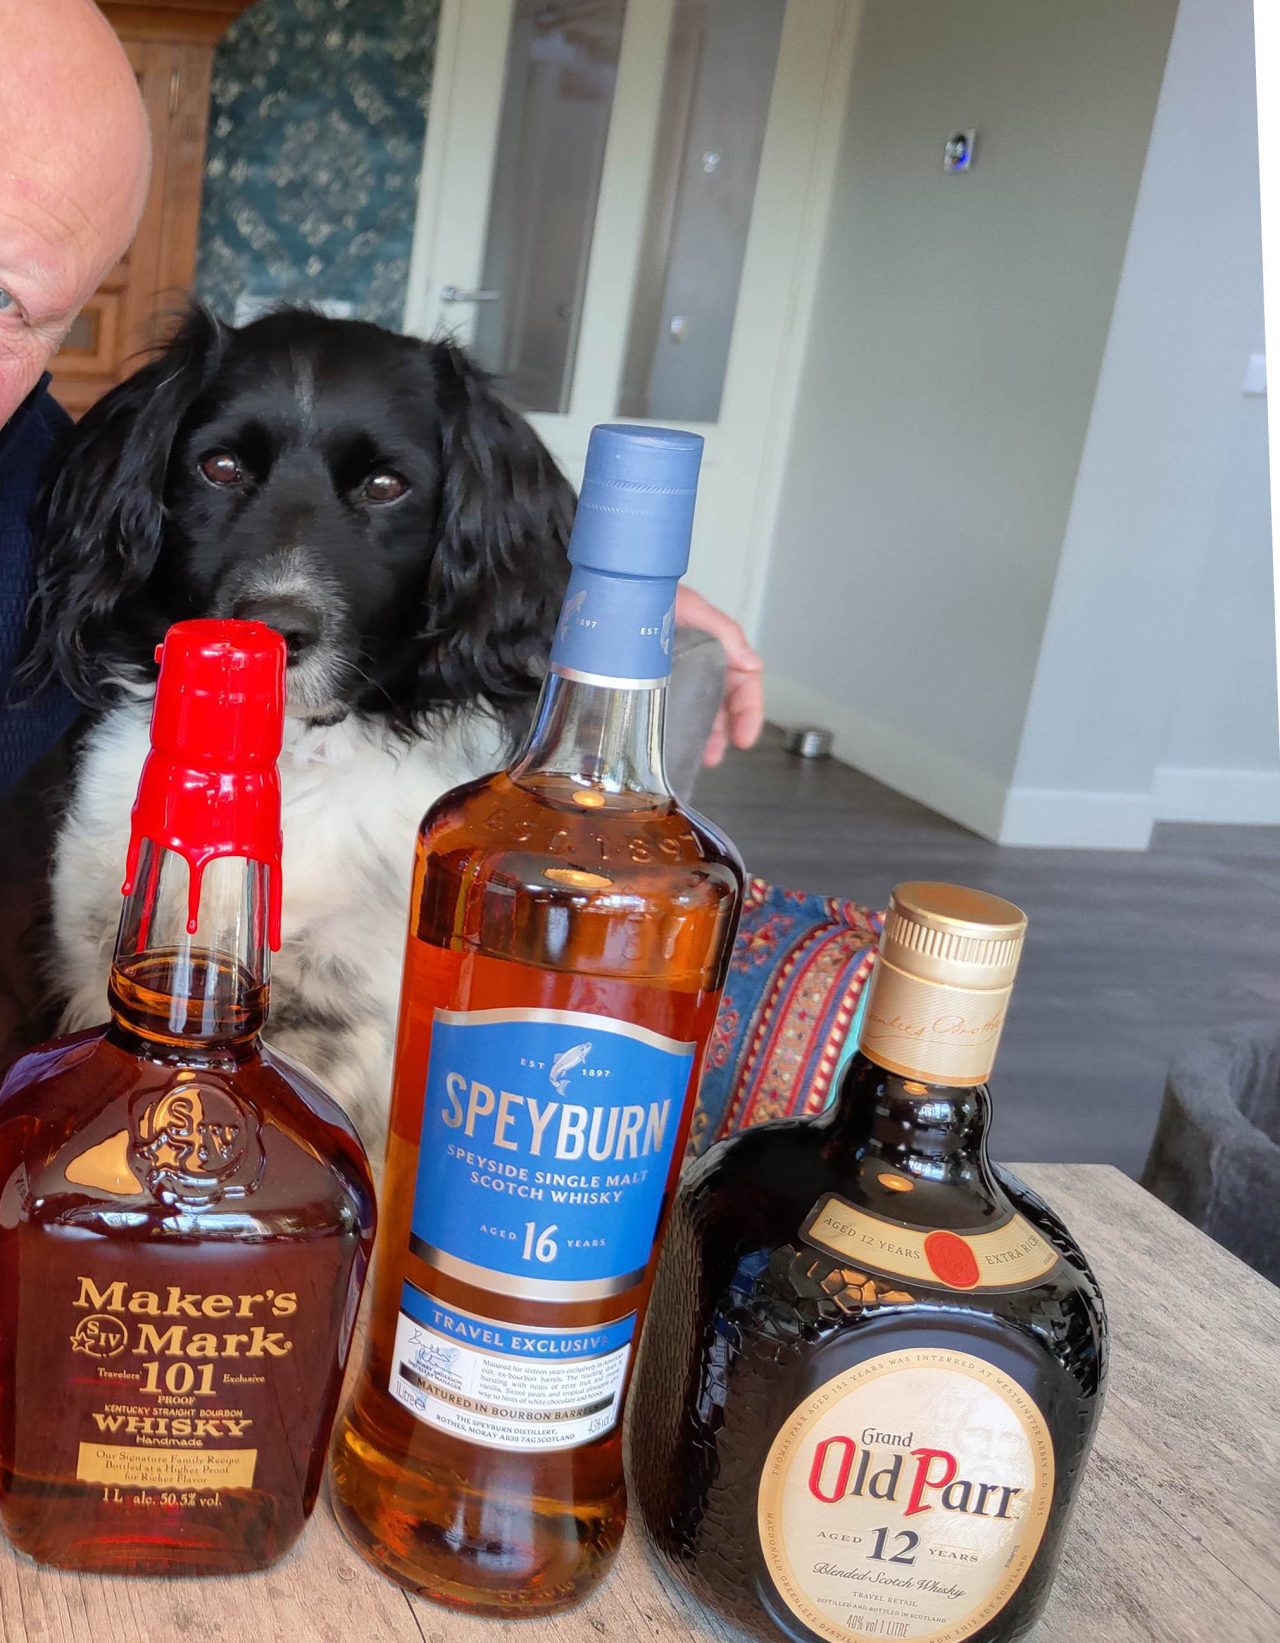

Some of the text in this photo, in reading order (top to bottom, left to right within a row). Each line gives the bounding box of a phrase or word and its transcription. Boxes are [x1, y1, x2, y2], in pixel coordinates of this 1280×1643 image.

[640, 627, 659, 635] EST
[520, 1057, 546, 1069] EST
[582, 1068, 611, 1078] 1897
[441, 1071, 672, 1162] SPEYBURN
[447, 1143, 649, 1188] SPEYSIDE SINGLE MALT
[470, 1171, 624, 1204] SCOTCH WHISKY
[479, 1221, 607, 1263] AGED 16 YEARS
[824, 1217, 921, 1260] AGED 12 YEARS
[984, 1247, 1022, 1265] EXTRA
[1023, 1233, 1040, 1253] RICH
[73, 1276, 298, 1318] Maker's
[432, 1309, 505, 1347] TRAVEL
[139, 1361, 217, 1395] 101
[849, 1362, 884, 1382] YEARS
[888, 1355, 912, 1366] WAS
[917, 1354, 976, 1370] INTERRED
[104, 1404, 243, 1417] KENTUCKY STRAIGHT BOURBON
[157, 1396, 196, 1405] PROOF
[417, 1377, 472, 1408] MATURED
[475, 1403, 488, 1413] IN
[491, 1406, 551, 1421] BOURBON
[92, 1412, 253, 1437] WHISKY
[456, 1414, 471, 1425] THE
[472, 1419, 513, 1434] SPEYBURN
[468, 1426, 498, 1438] MORAY
[537, 1433, 576, 1444] SCOTLAND
[861, 1427, 913, 1447] Grand
[135, 1435, 204, 1448] Handmade
[96, 1449, 241, 1466] Our Signature Family Recipe
[105, 1460, 143, 1472] Bottled
[165, 1463, 200, 1475] Higher
[140, 1472, 209, 1485] Richer Flavor
[807, 1435, 1023, 1518] Old Parr
[159, 1493, 197, 1507] 50.5%
[817, 1526, 979, 1567] AGED 12 YEARS
[812, 1562, 967, 1600] Blended Scotch Whisky
[816, 1597, 948, 1624] DISTILLED AND BOTTLED SCOTLAND
[852, 1590, 918, 1608] TRAVEL RETAIL
[846, 1613, 864, 1631] 40%
[865, 1616, 878, 1633] vol
[886, 1620, 910, 1639] LITRE
